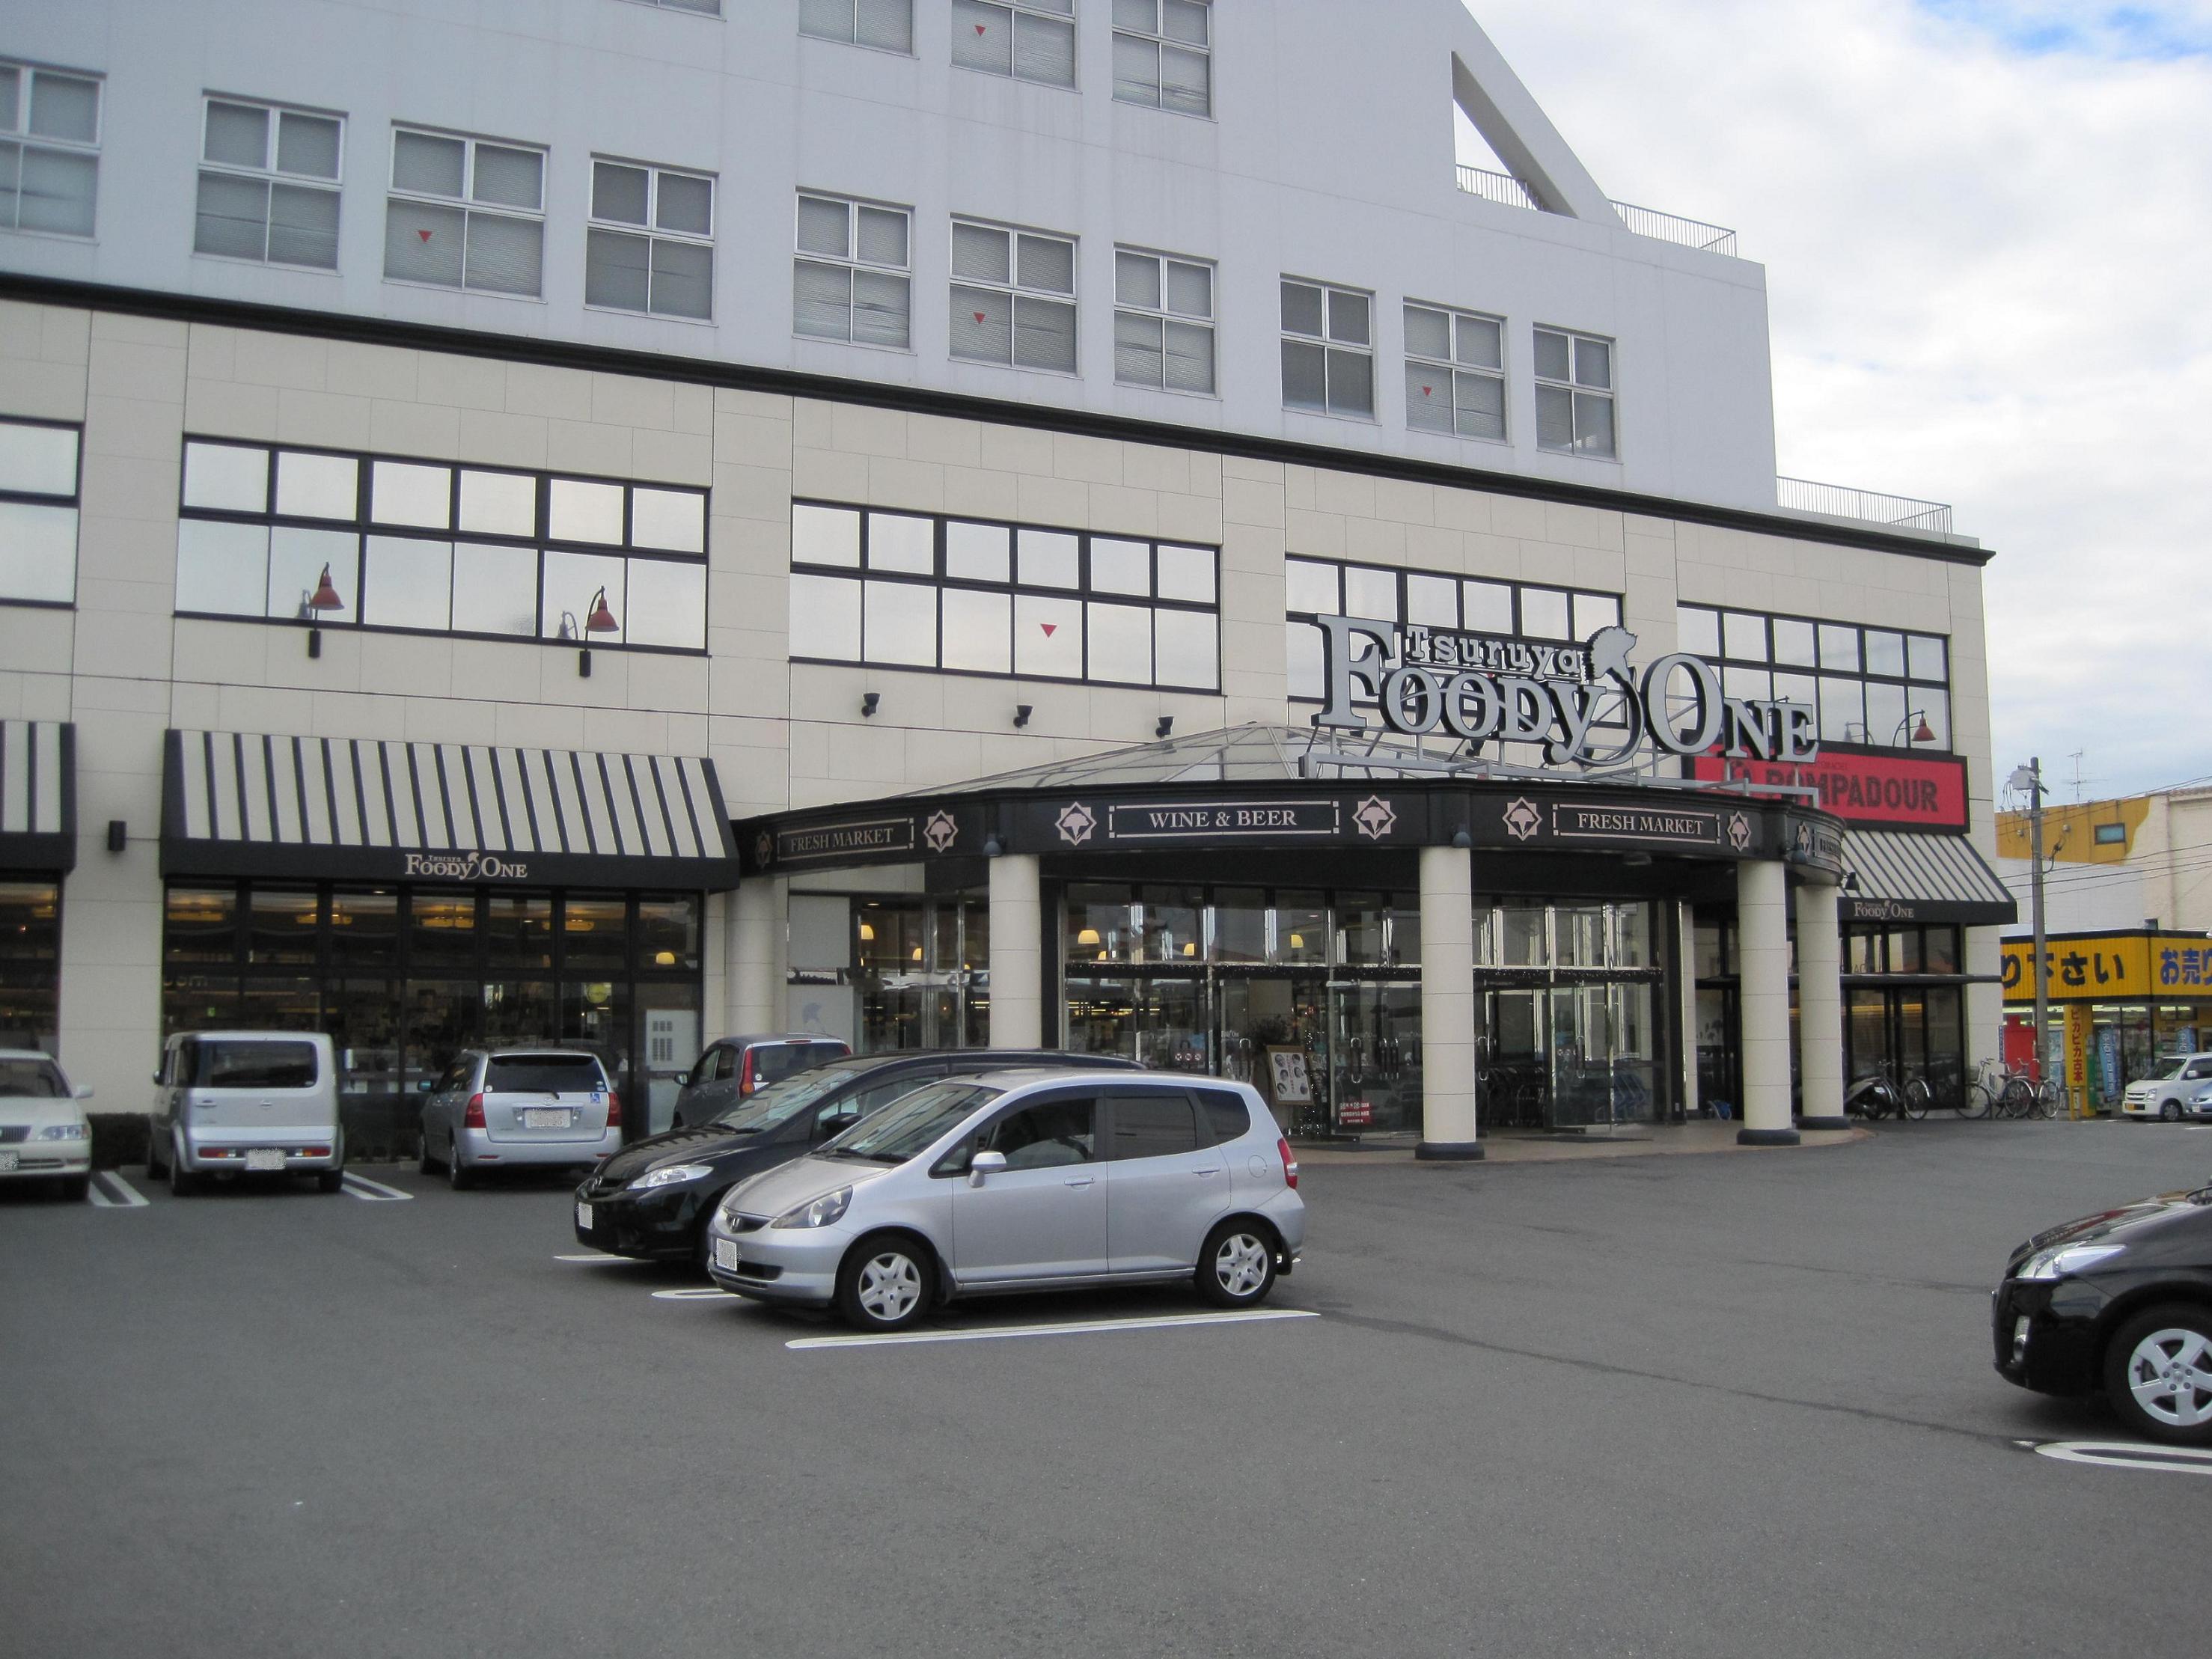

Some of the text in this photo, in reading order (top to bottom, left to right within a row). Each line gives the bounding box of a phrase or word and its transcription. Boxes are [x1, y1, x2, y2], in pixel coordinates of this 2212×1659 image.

[1407, 624, 1582, 679] Tsuruya
[1641, 653, 1820, 763] ONE
[1765, 769, 1938, 813] POMPADOUR
[1149, 810, 1298, 828] WINE & BEER
[1577, 813, 1703, 835] FRESH MARKET
[790, 828, 894, 852] FRESH MARKET
[480, 857, 528, 879] ONE
[1890, 902, 1914, 918] ONE
